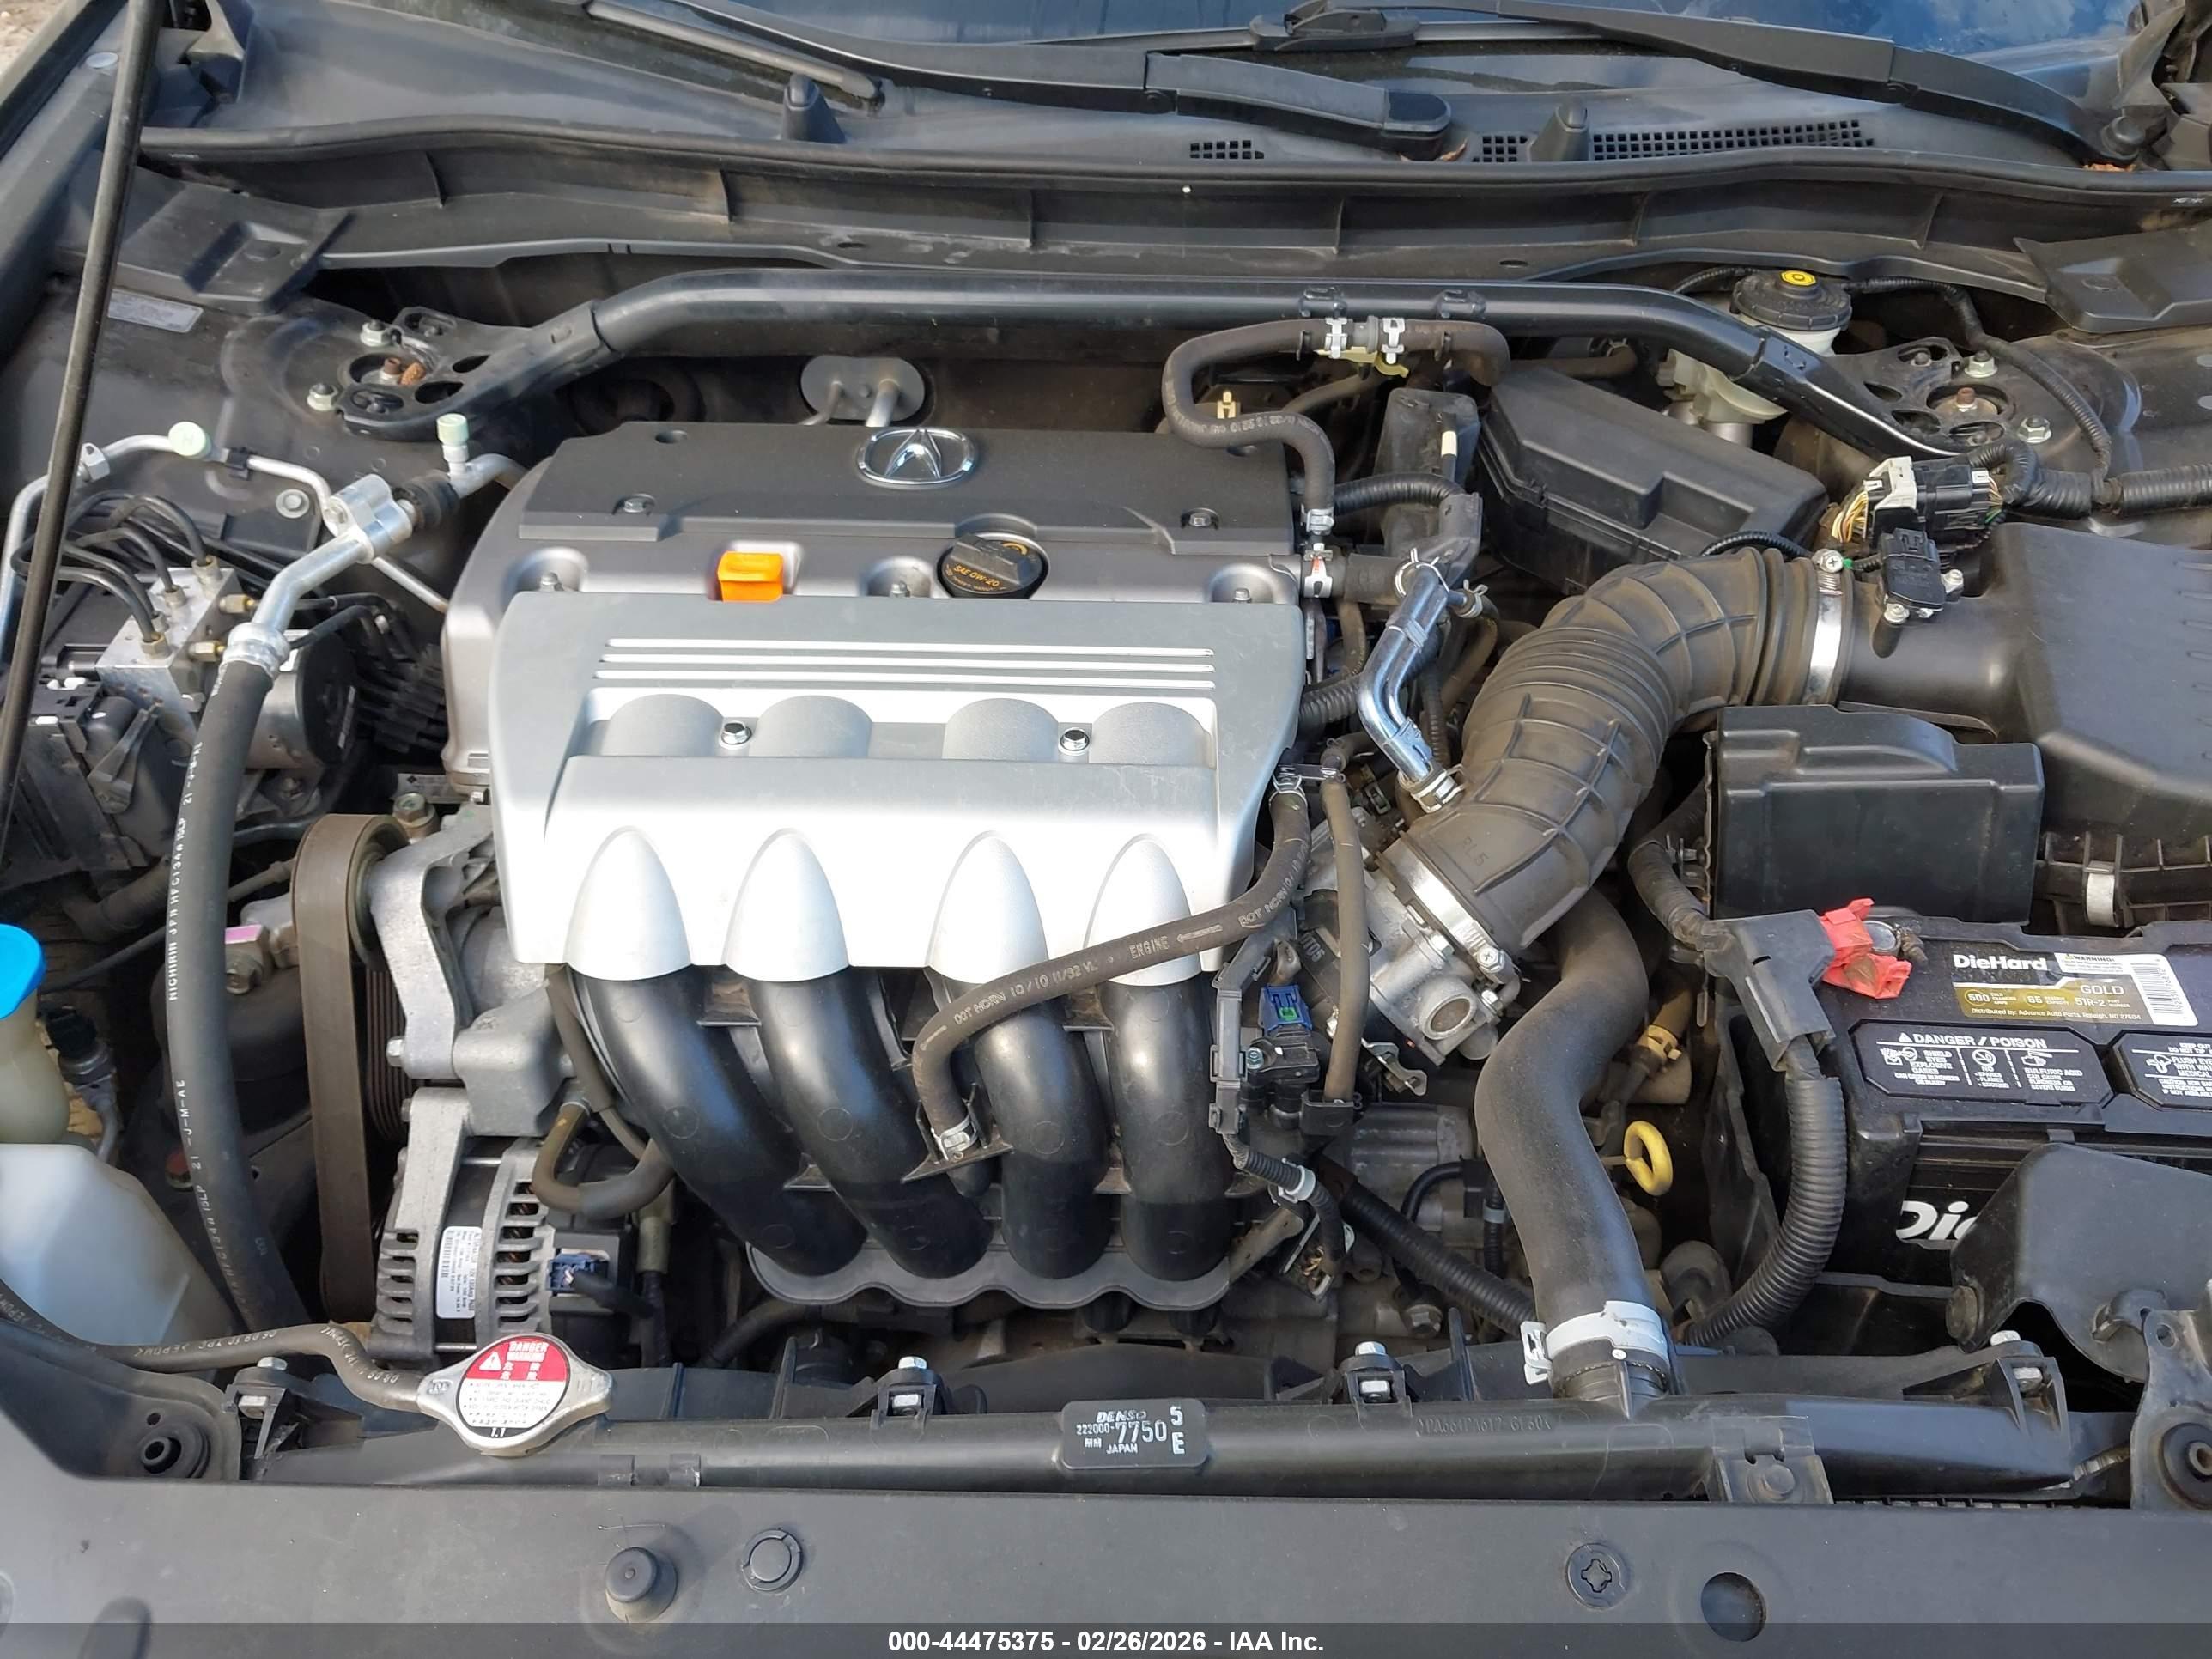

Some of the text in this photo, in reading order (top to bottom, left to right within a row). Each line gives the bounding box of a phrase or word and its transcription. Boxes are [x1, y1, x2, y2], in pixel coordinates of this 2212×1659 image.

[953, 564, 971, 576] SAE
[969, 570, 1000, 587] 0W-20
[1129, 935, 1169, 960] ENGINE
[1953, 954, 2049, 971] DieHard
[168, 942, 179, 1001] NICHIRIN
[2080, 984, 2125, 996] GOLD
[2027, 995, 2044, 1004] 85
[2074, 996, 2107, 1007] 51R-2
[1971, 1007, 2007, 1016] Distributed
[1912, 1033, 2048, 1048] DANGER / POISON
[1923, 1049, 1953, 1058] SHIELD
[2171, 1056, 2212, 1066] FLUSH EYE
[2024, 1066, 2064, 1076] SULFURIC
[508, 1341, 550, 1352] DANGER
[1096, 1409, 1148, 1424] DENSO
[1169, 1405, 1184, 1426] 5
[490, 1427, 507, 1437] 1.1
[1085, 1437, 1103, 1449] MM
[1106, 1443, 1139, 1455] JAPAN
[1171, 1431, 1186, 1455] E
